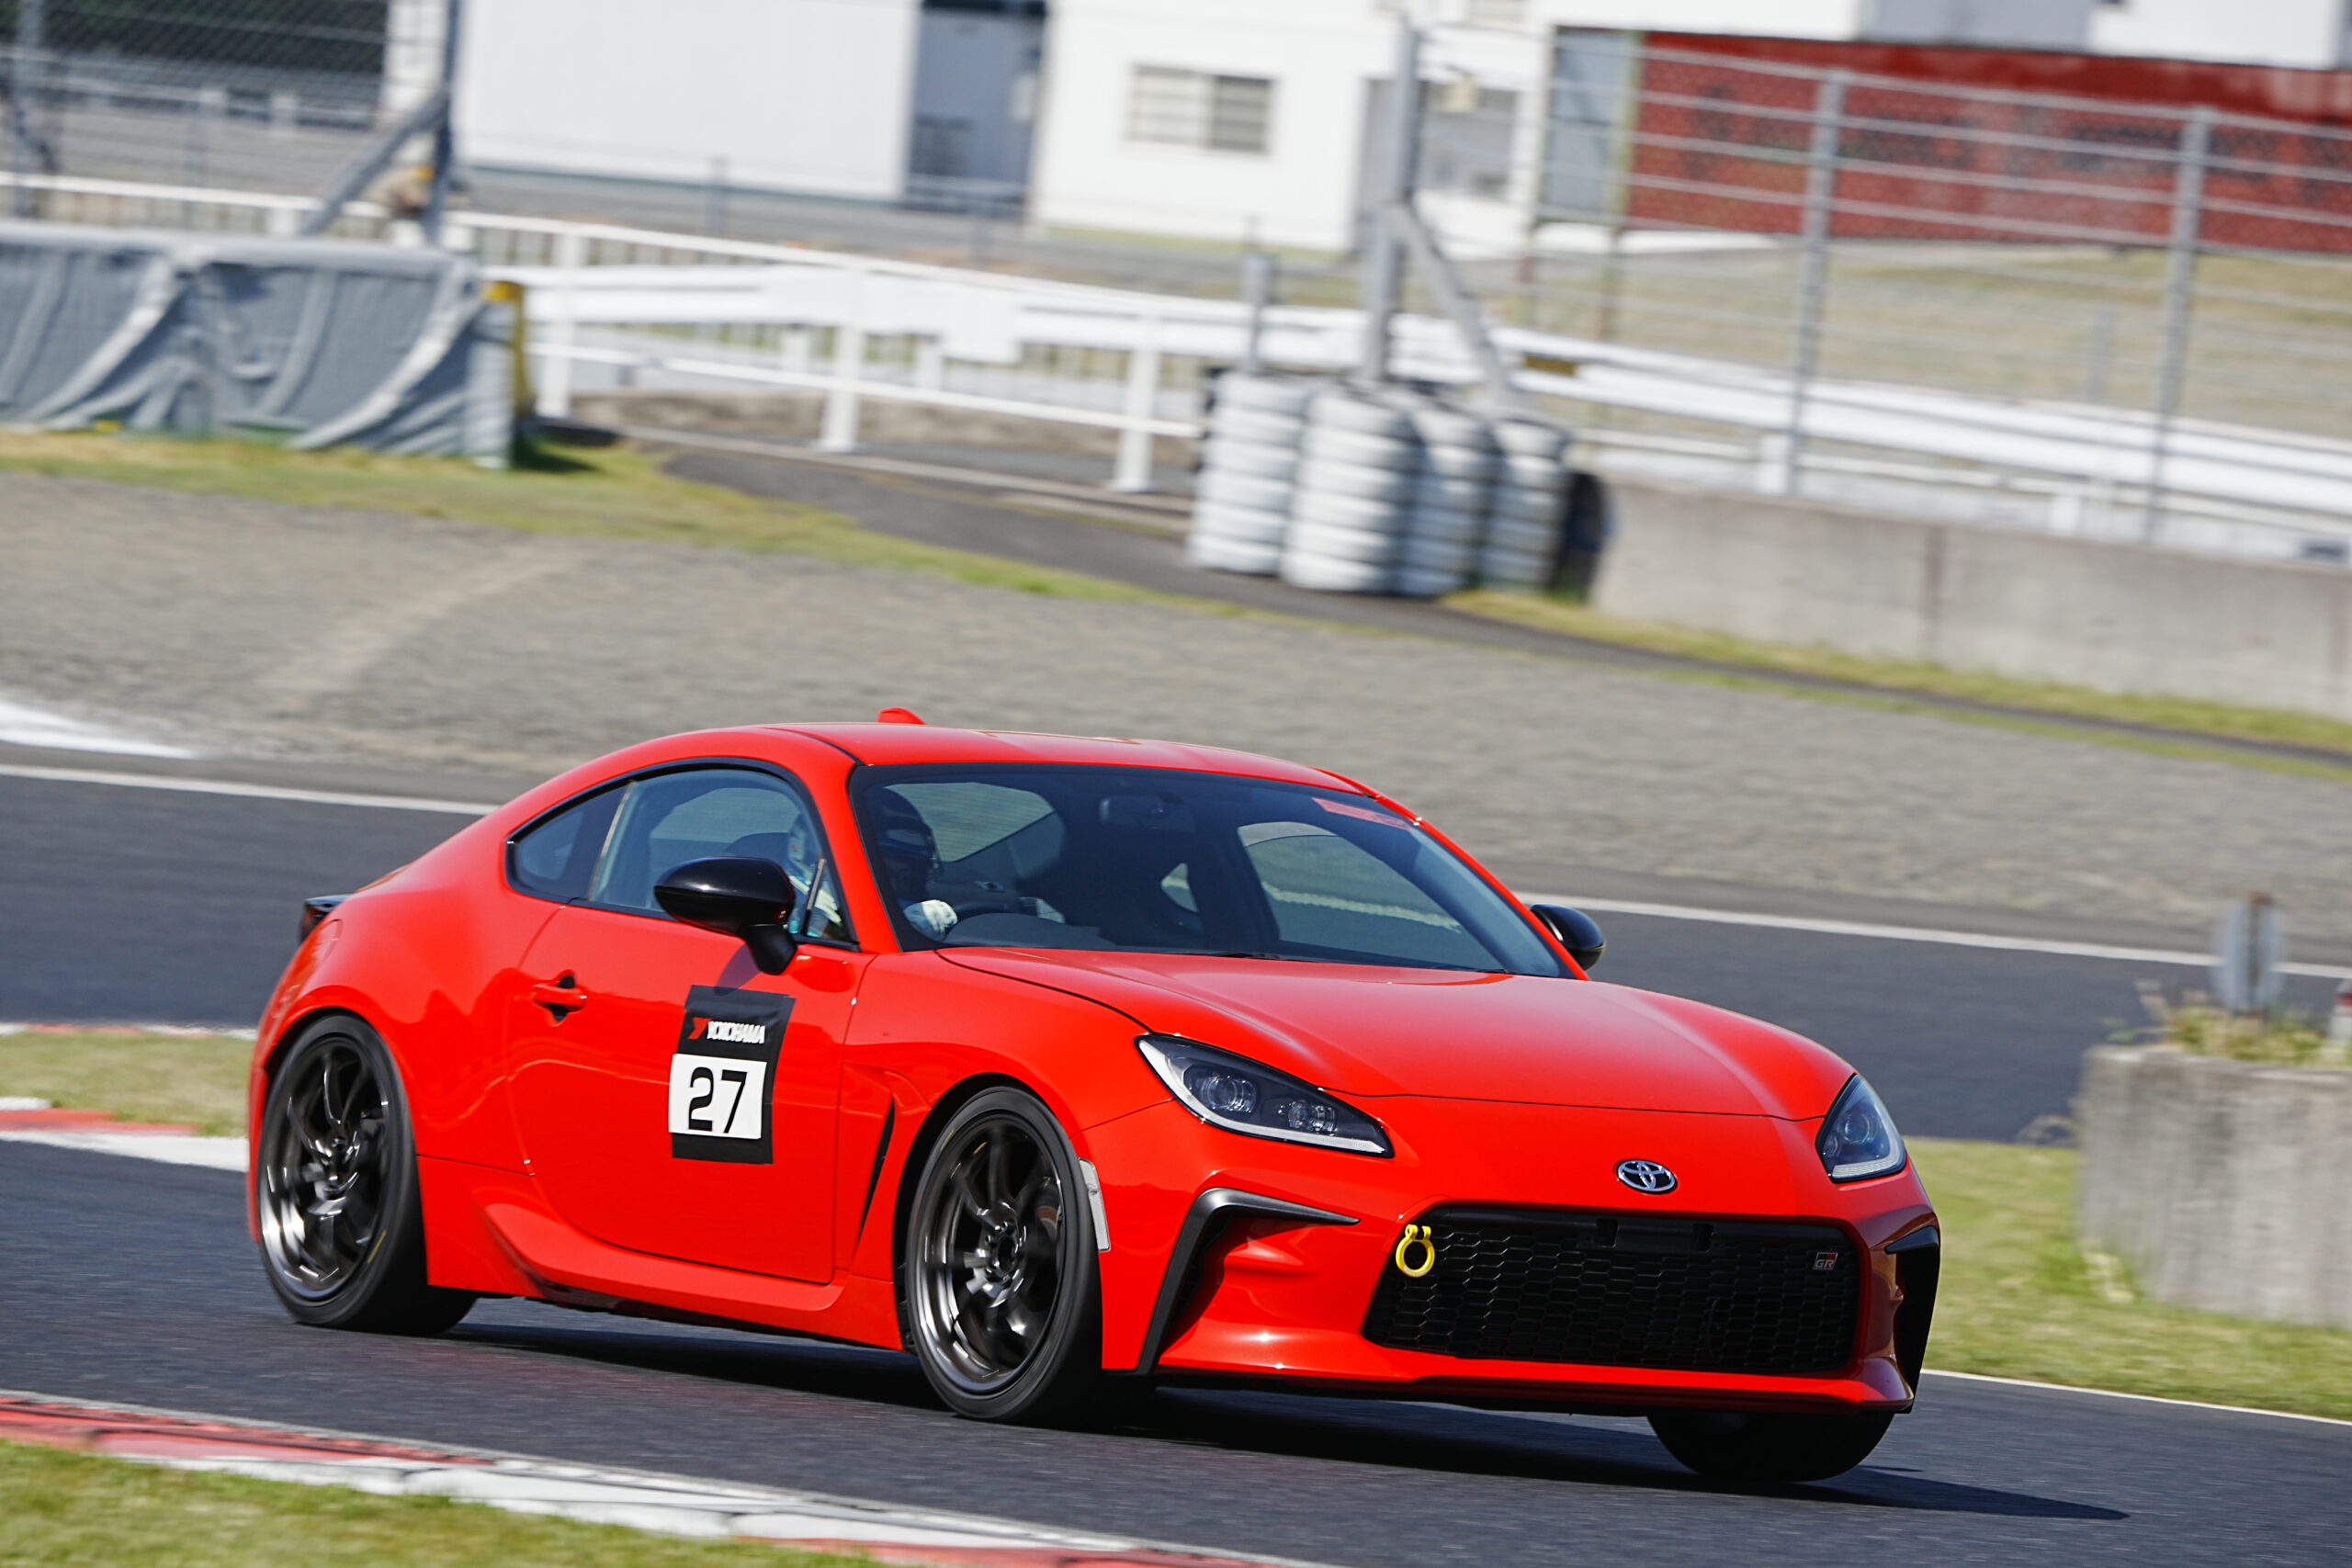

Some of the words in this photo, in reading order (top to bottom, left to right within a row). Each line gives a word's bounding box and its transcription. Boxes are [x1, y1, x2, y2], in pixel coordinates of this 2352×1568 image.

[707, 1021, 765, 1044] YOKOHAMA
[688, 1066, 748, 1134] 27
[1815, 1259, 1835, 1269] GR
